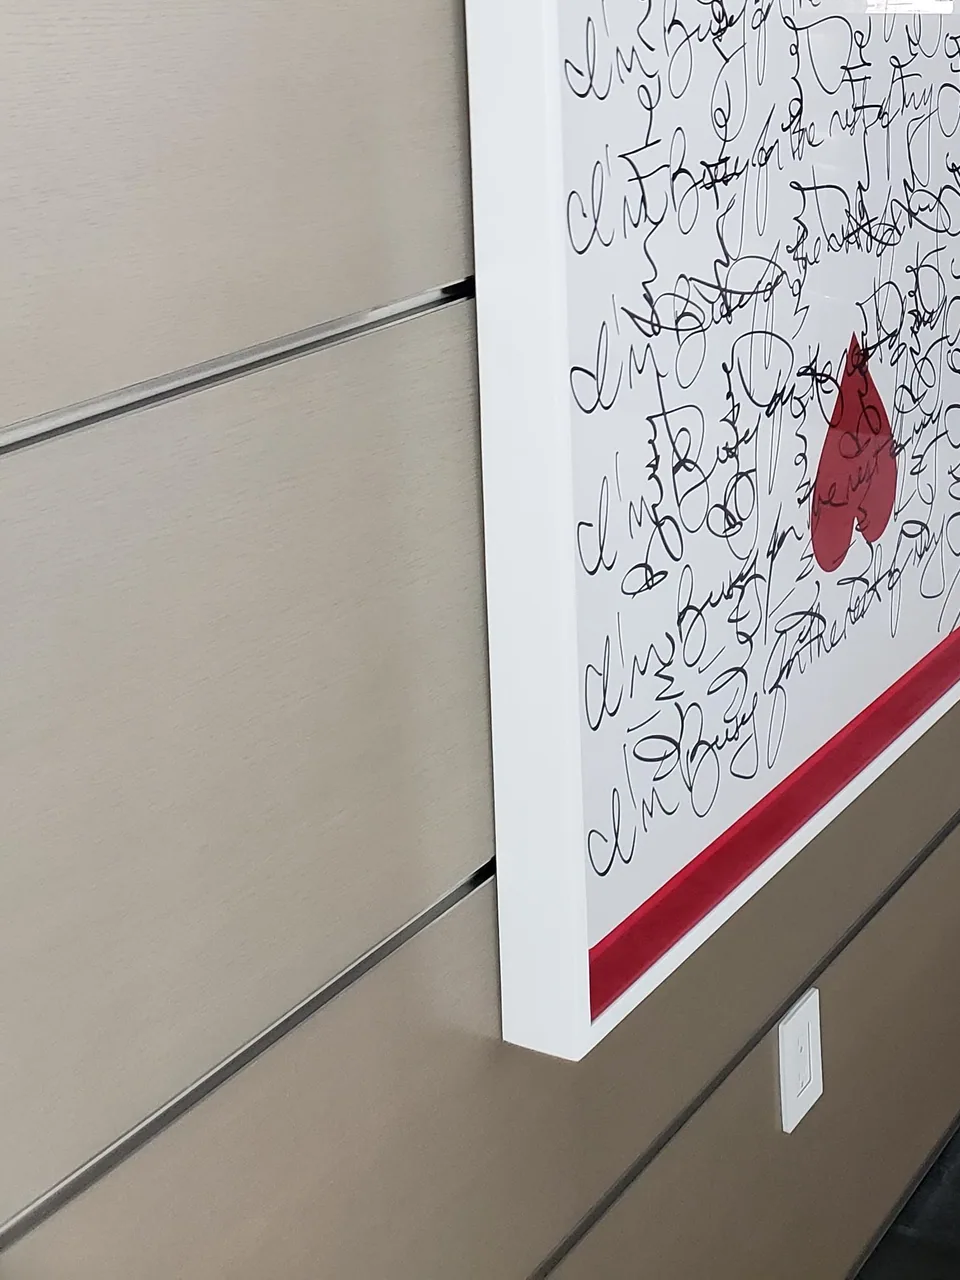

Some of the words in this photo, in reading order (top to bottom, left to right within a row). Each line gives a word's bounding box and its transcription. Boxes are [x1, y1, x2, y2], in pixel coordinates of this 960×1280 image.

[567, 145, 668, 255] I'm
[670, 127, 750, 260] Busy
[752, 104, 783, 236] for
[781, 115, 824, 161] the
[829, 104, 883, 136] rest
[570, 294, 668, 414] I'm
[577, 452, 665, 575] I'm
[672, 412, 760, 560] Busy
[585, 613, 675, 730] I'm
[677, 548, 761, 667] Busy
[765, 502, 803, 645] for
[588, 744, 680, 877] I'm
[679, 693, 759, 817] Busy
[764, 628, 806, 769] for
[797, 603, 839, 663] the
[843, 544, 882, 640] rest
